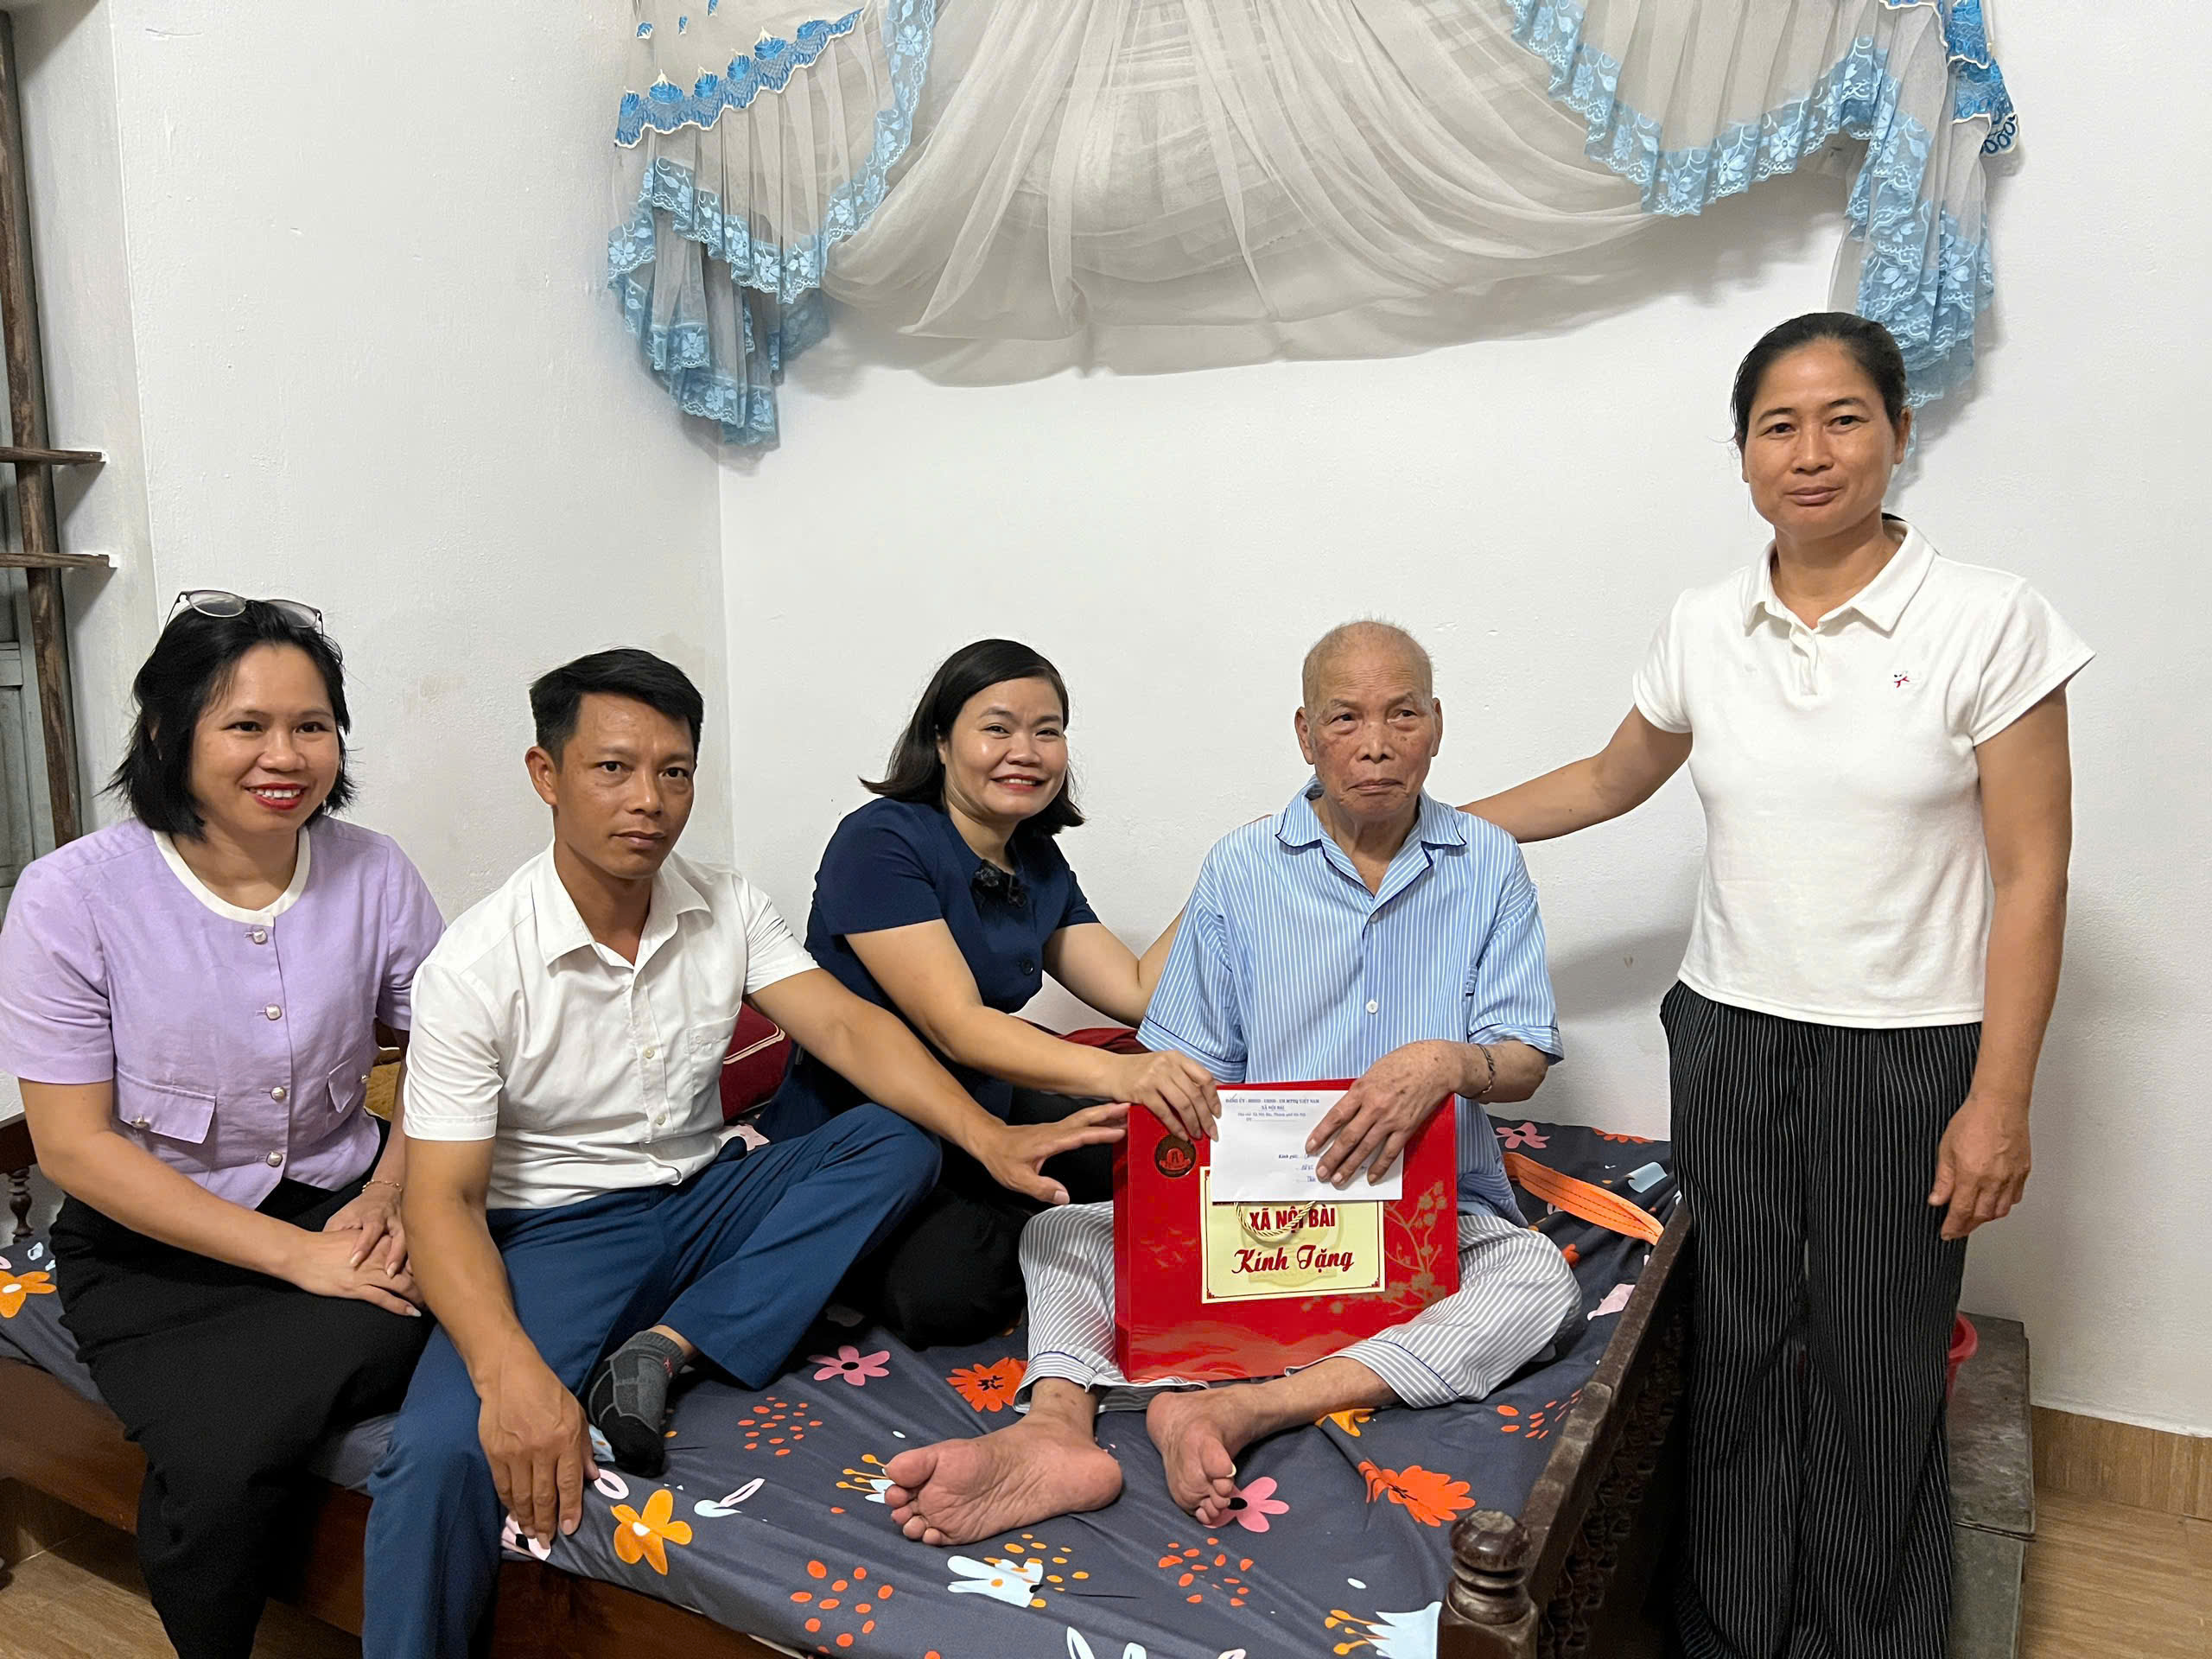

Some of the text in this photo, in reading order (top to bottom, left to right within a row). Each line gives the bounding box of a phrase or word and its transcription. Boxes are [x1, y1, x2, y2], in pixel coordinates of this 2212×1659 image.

[1249, 1204, 1336, 1233] XÃ NỘI BÀI
[1231, 1244, 1355, 1274] Kính Tặng
